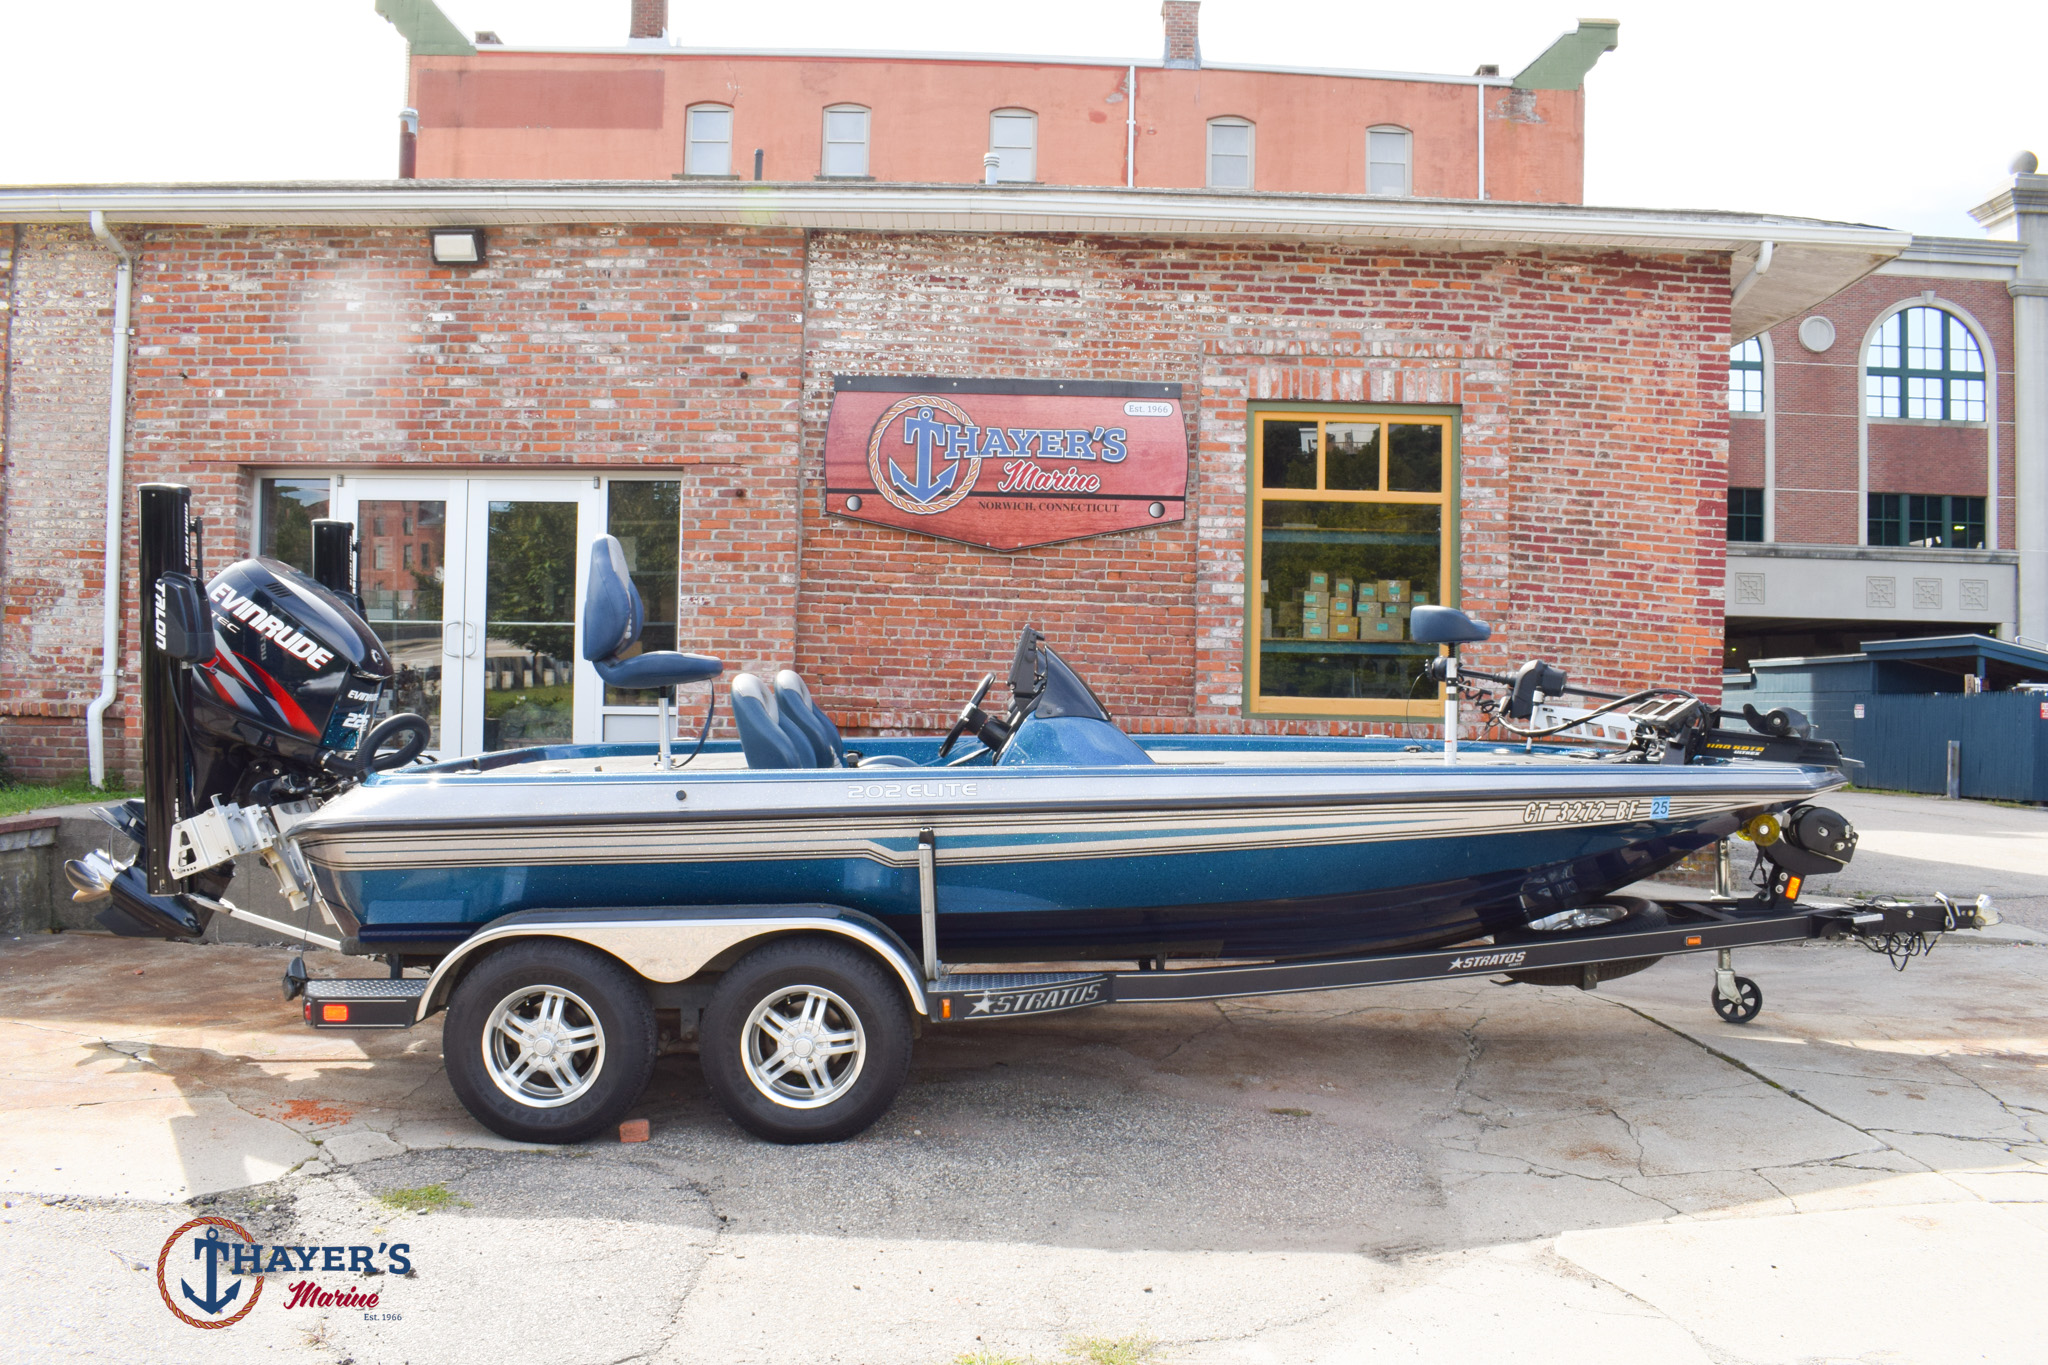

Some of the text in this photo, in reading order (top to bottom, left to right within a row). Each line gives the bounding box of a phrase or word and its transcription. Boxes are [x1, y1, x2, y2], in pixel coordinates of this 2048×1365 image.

[1129, 405, 1168, 415] Est. 1966
[904, 416, 1128, 502] THAYER'S
[998, 459, 1101, 494] Marine
[978, 501, 1120, 514] NORWICH, CONNECTICUT
[154, 582, 167, 650] TALON
[210, 582, 335, 671] EVINRUDE
[211, 610, 240, 634] TEC
[847, 783, 977, 799] 202 ELITE
[1523, 800, 1640, 824] CT 3272 BF
[1652, 801, 1668, 816] 25
[1463, 951, 1526, 969] STRATOS
[993, 983, 1101, 1014] STRATOS
